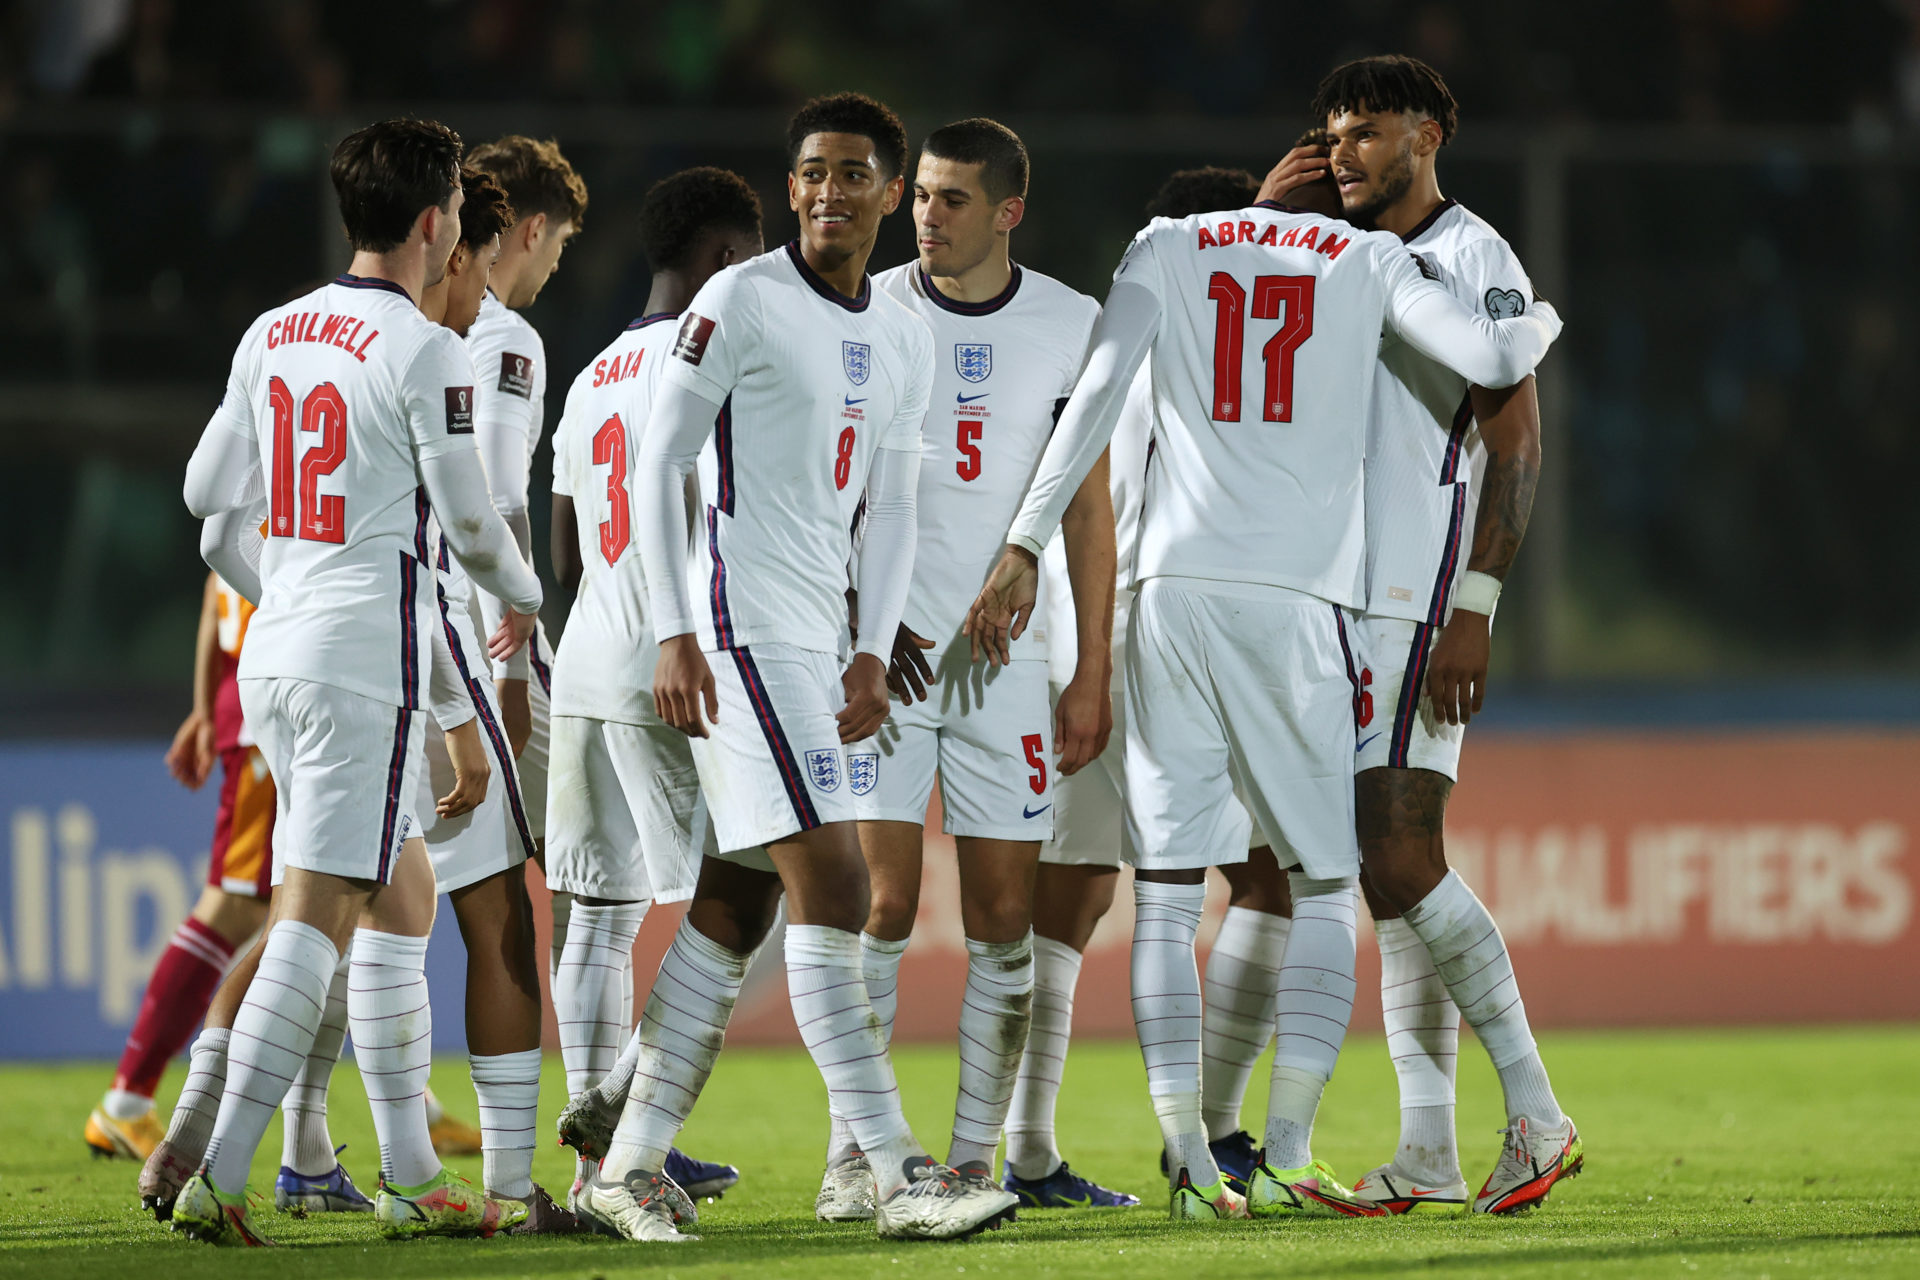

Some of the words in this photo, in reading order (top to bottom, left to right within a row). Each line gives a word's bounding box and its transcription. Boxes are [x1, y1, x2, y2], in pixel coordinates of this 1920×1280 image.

[1198, 220, 1351, 261] ABRAHAM
[267, 312, 380, 364] CHILWELL
[592, 347, 646, 389] SAKA
[1207, 271, 1317, 424] 17
[269, 375, 348, 545] 12
[834, 425, 856, 492] 8
[956, 420, 983, 482] 5
[592, 412, 631, 569] 3
[1359, 667, 1374, 729] 6
[1021, 733, 1047, 796] 5
